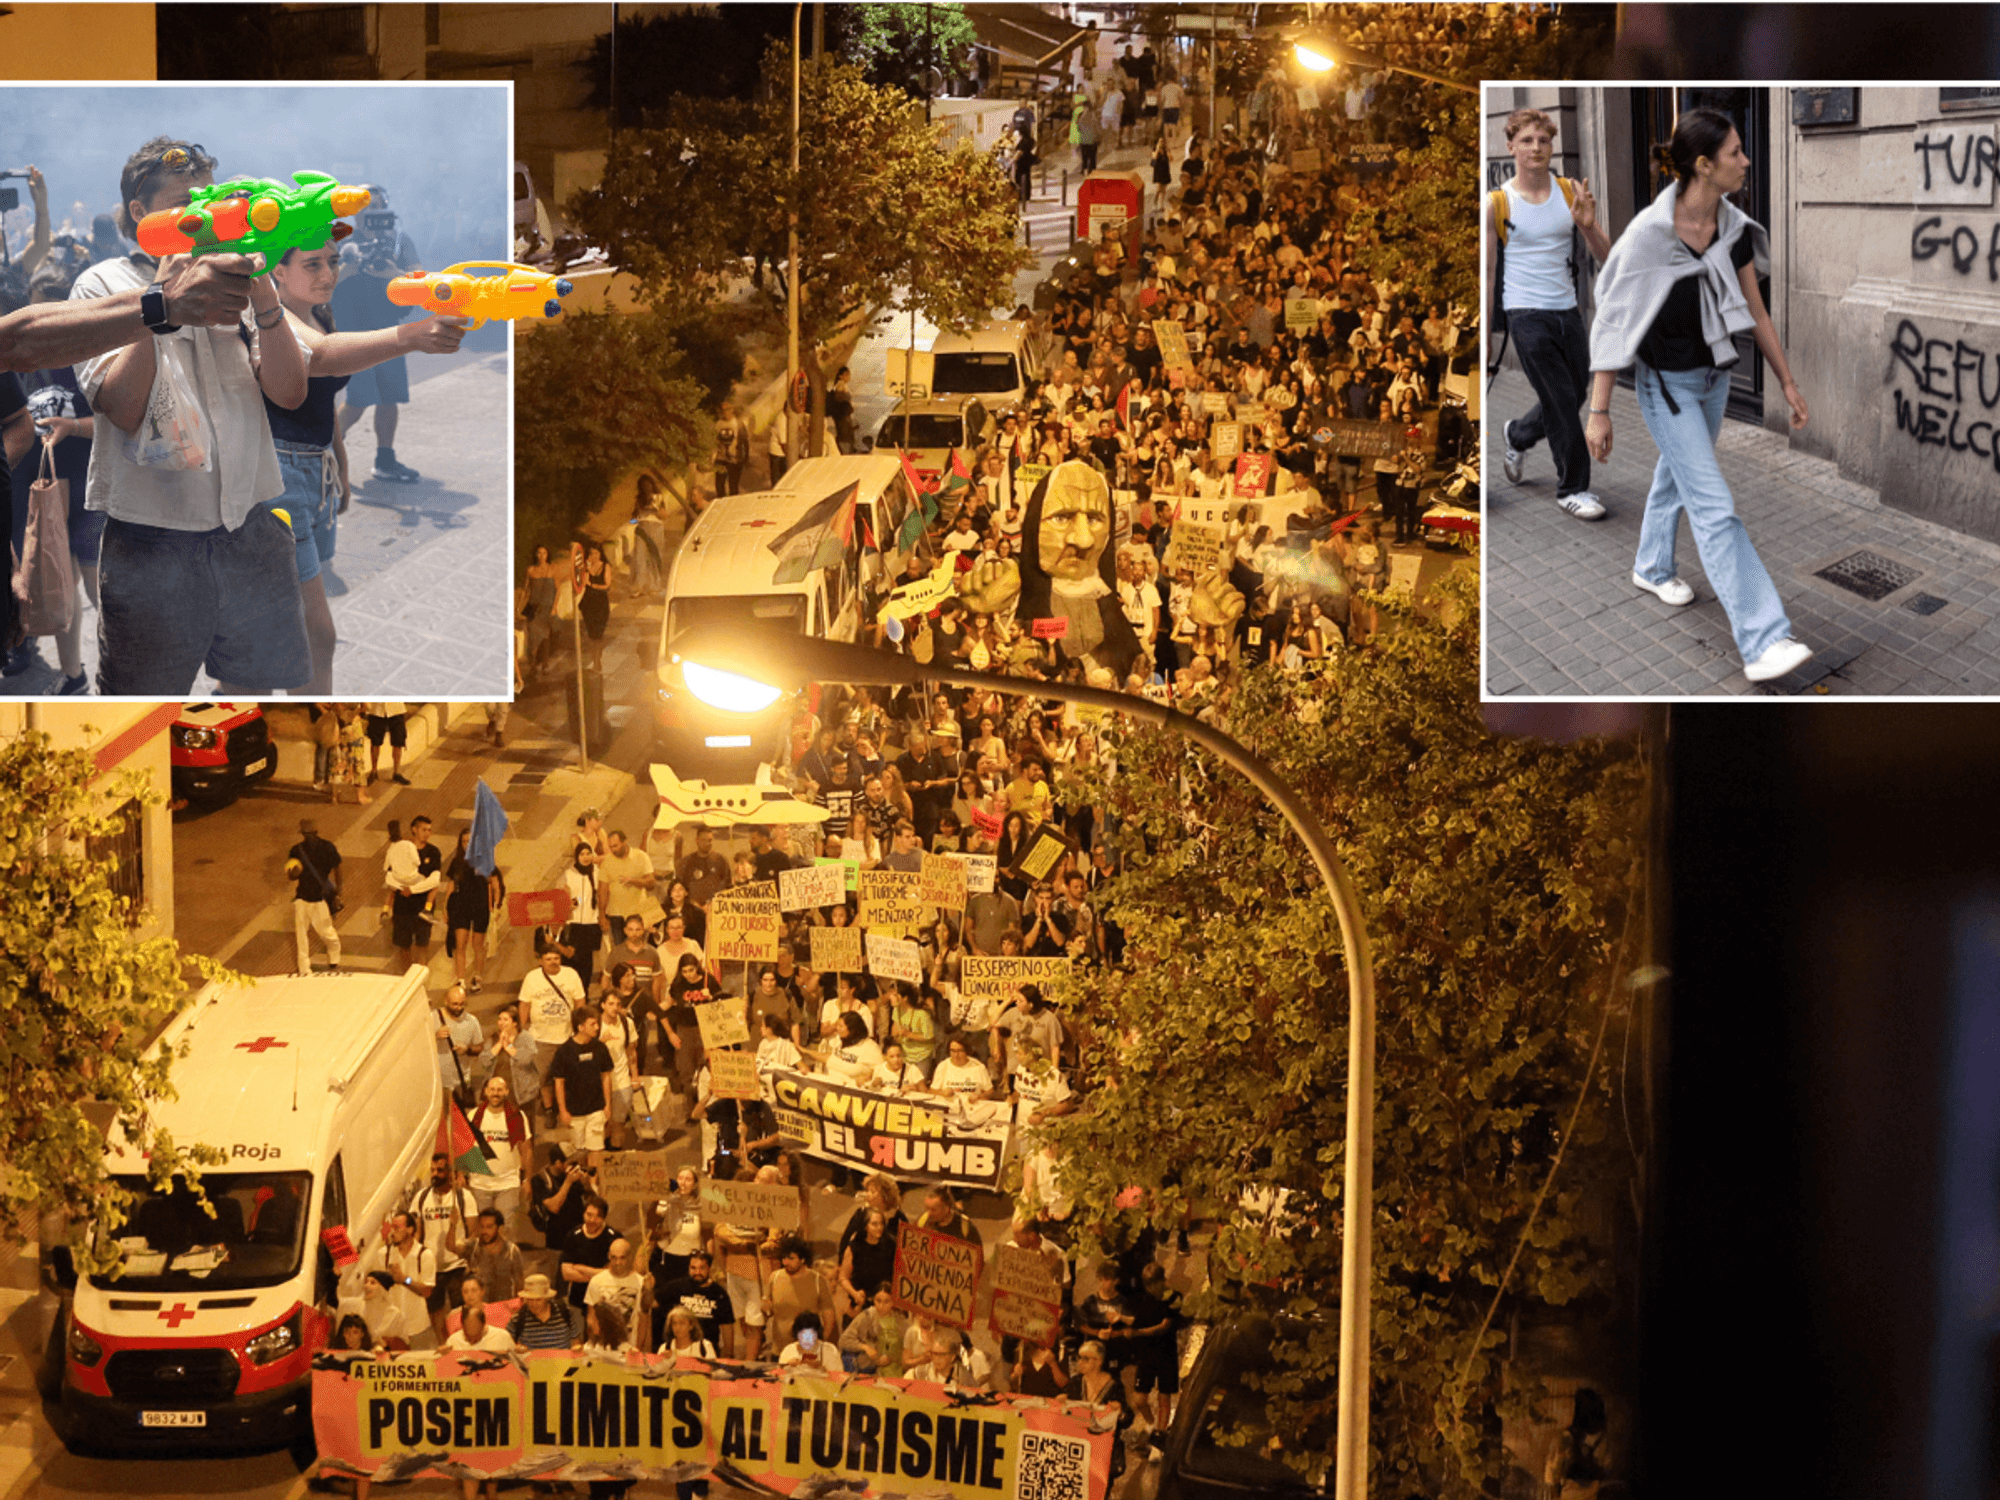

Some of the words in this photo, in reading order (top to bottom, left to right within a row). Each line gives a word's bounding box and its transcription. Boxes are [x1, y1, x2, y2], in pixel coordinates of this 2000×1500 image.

[862, 872, 921, 886] MASSIFICACI
[720, 916, 737, 931] 20
[867, 905, 923, 925] MENJAR?
[718, 941, 772, 958] HABITANT
[775, 1079, 944, 1138] CANVIEM
[823, 1121, 866, 1160] EL
[232, 1143, 282, 1161] Roja
[936, 1242, 973, 1268] UNA
[904, 1257, 974, 1296] VIVIENDA
[898, 1275, 966, 1321] DIGNA
[354, 1365, 364, 1379] A
[368, 1364, 427, 1379] EIVISSA
[381, 1381, 461, 1394] FORMENTERA
[368, 1396, 510, 1449] POSEM
[532, 1366, 704, 1449] LÍMITS
[720, 1406, 768, 1461] AL
[782, 1396, 1008, 1490] TURISME
